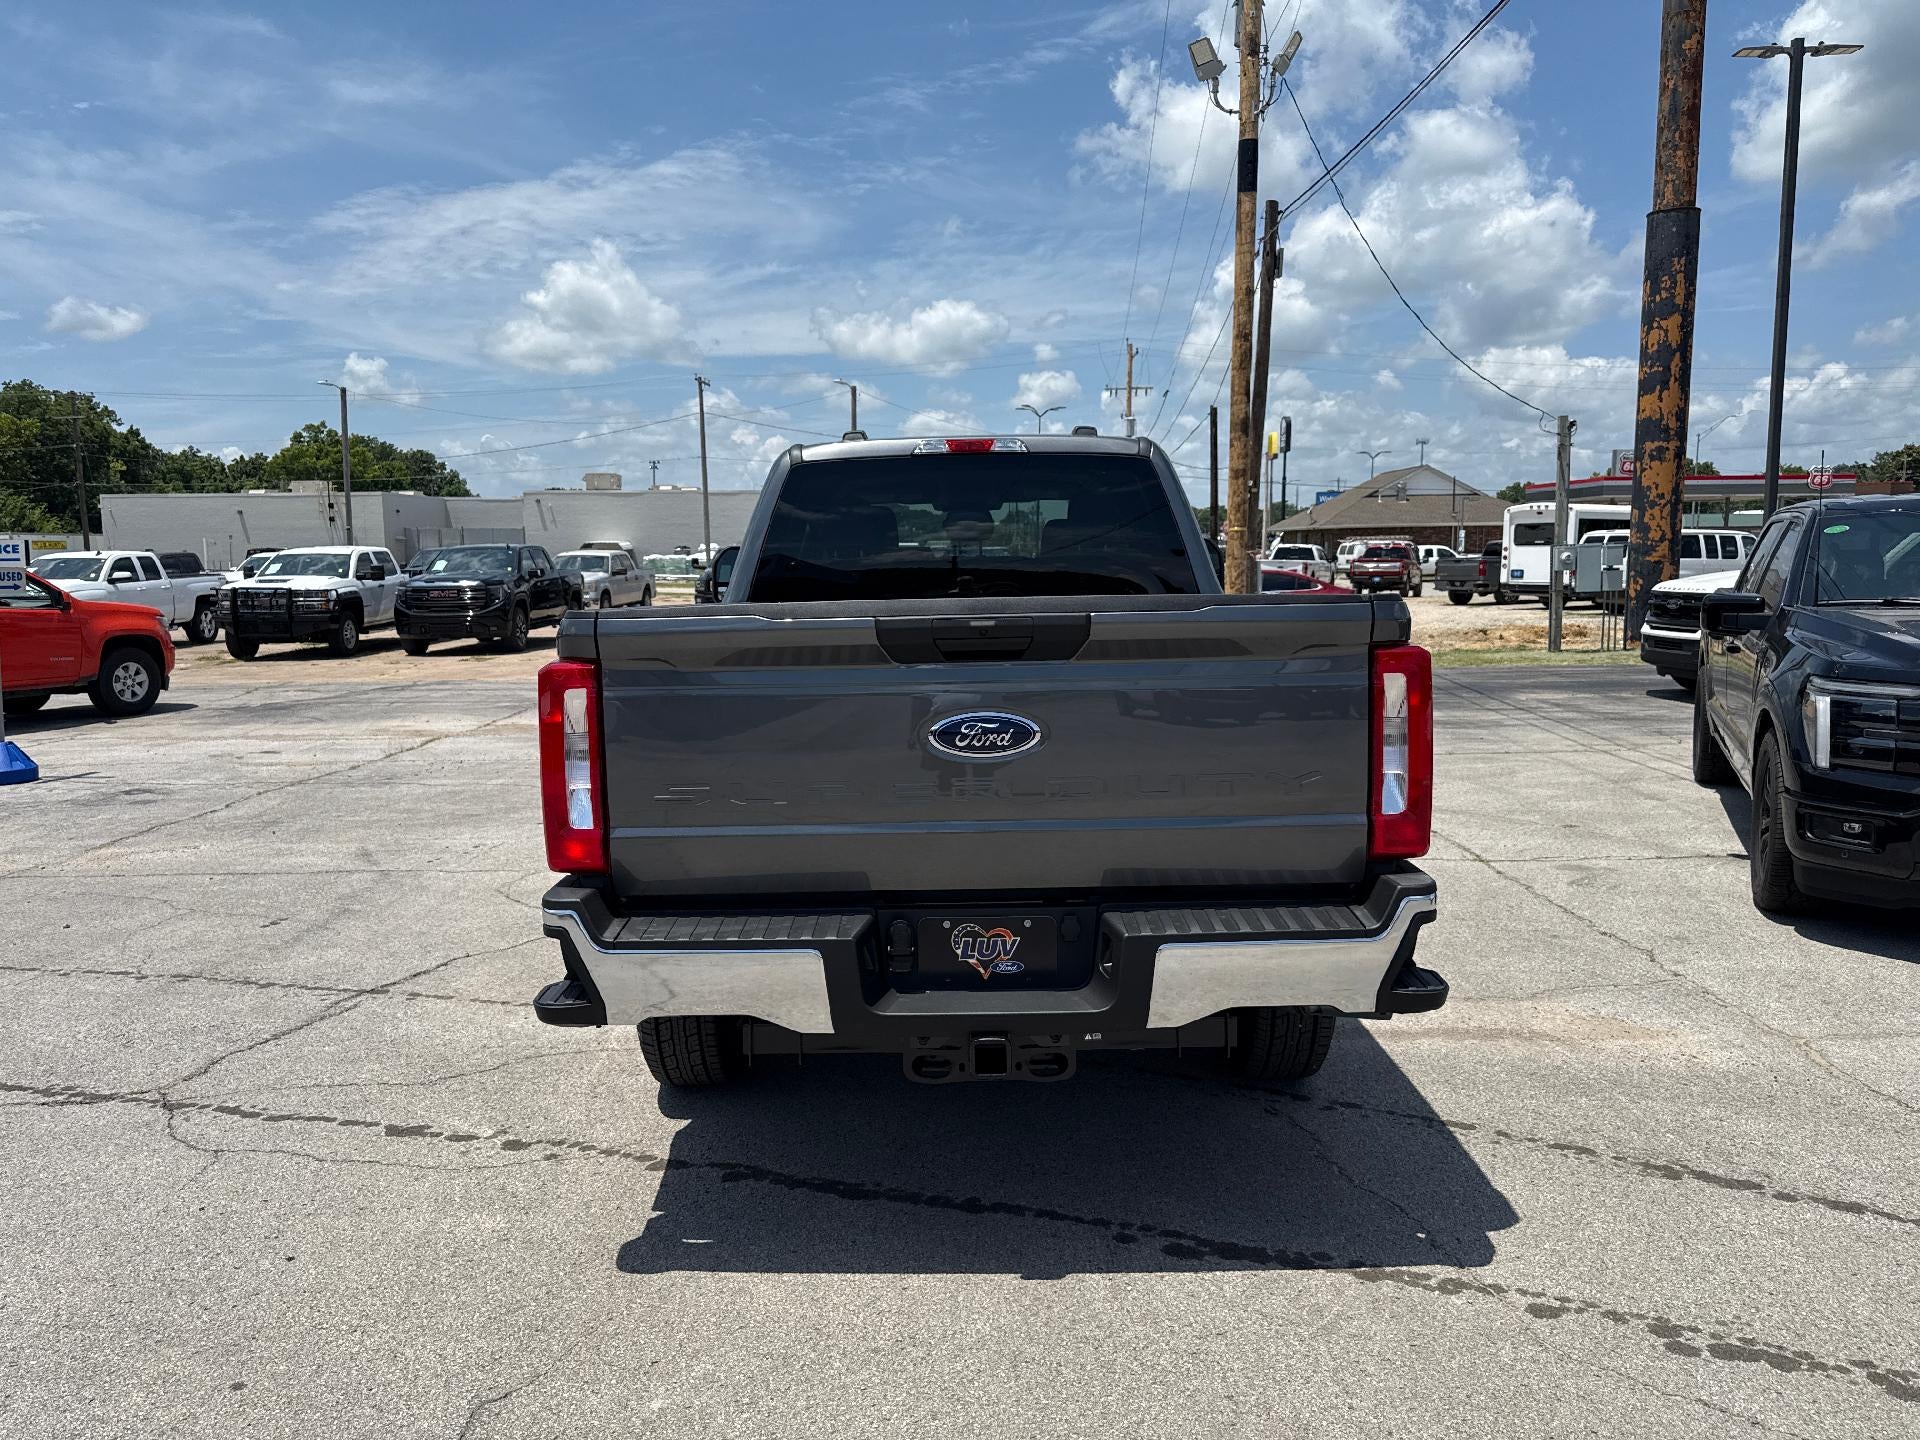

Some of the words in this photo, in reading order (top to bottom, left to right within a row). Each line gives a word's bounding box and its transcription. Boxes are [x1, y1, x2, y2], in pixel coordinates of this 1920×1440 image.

[0, 571, 22, 581] USED
[429, 590, 458, 598] GMC
[955, 722, 1015, 747] Ford
[959, 937, 1021, 960] LUV
